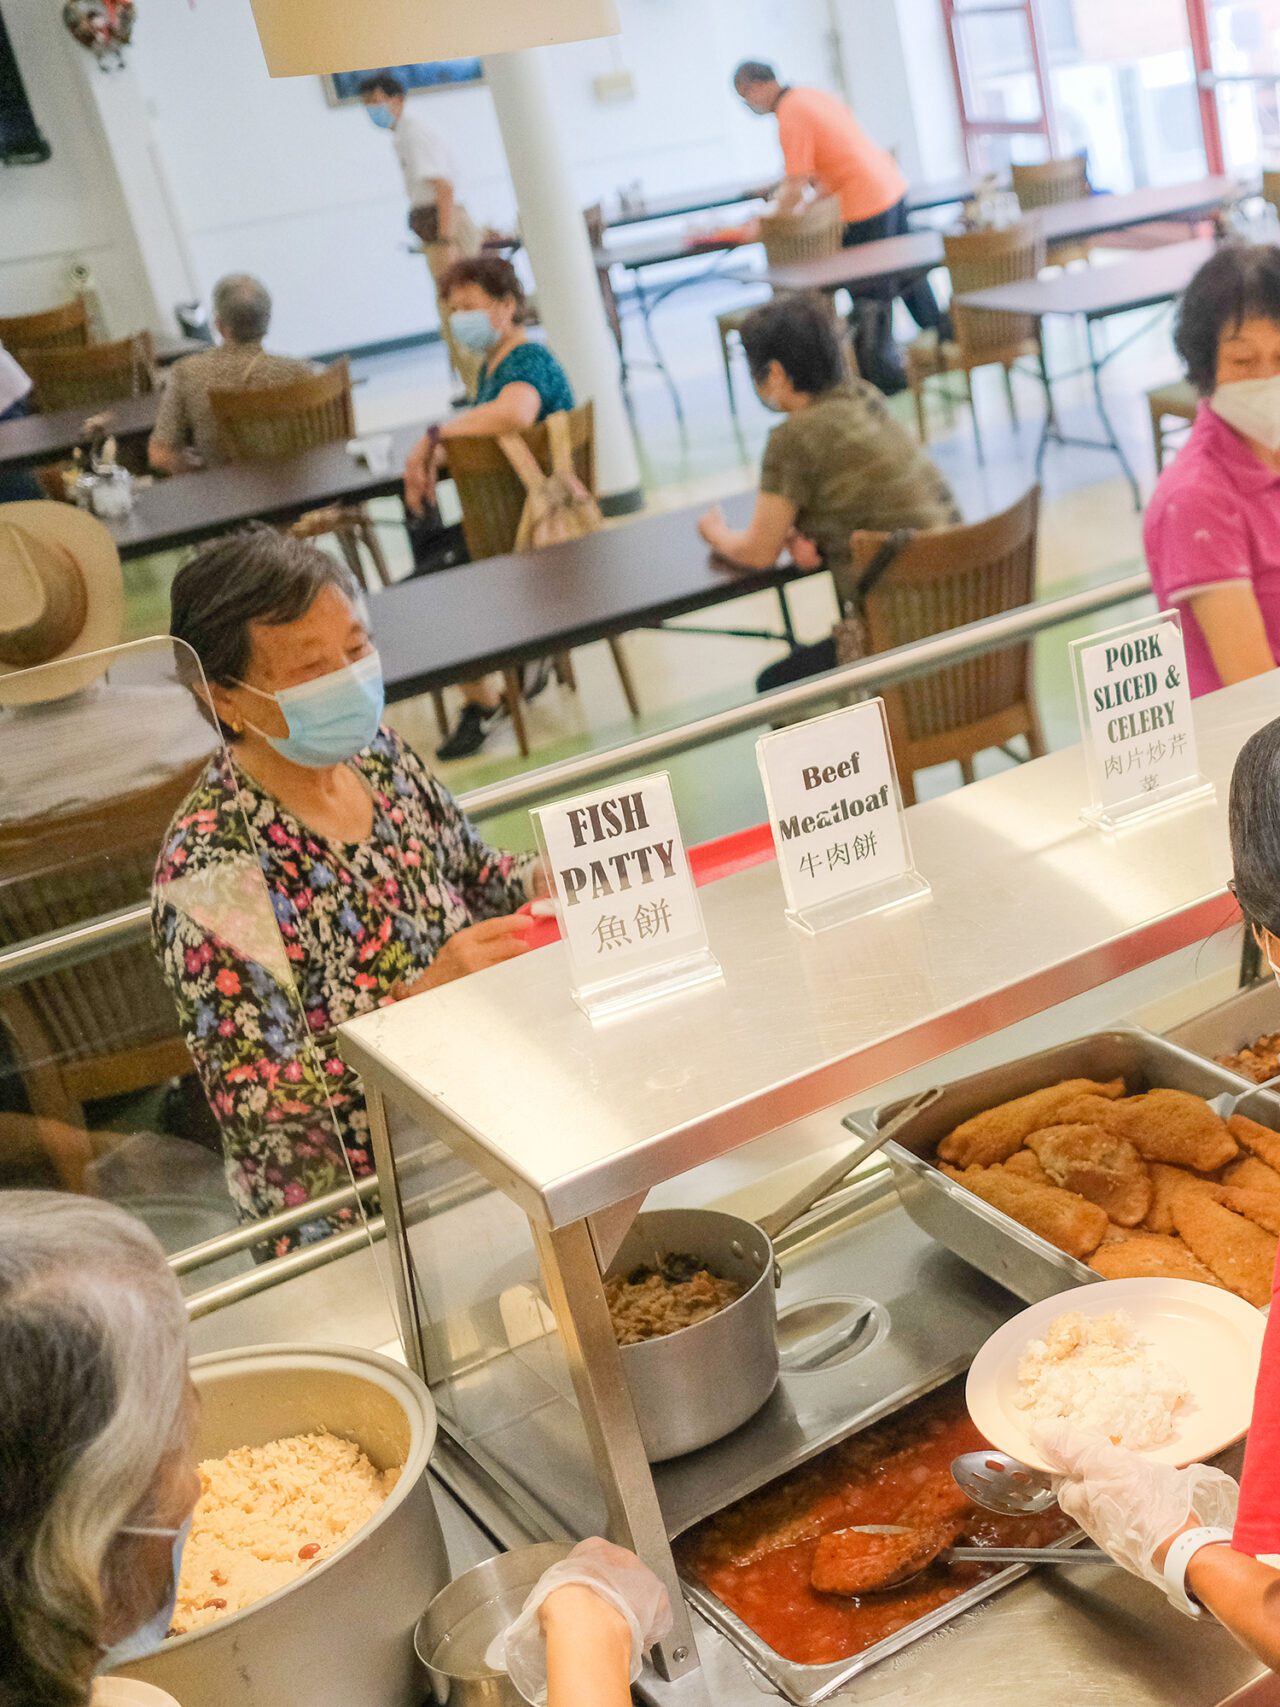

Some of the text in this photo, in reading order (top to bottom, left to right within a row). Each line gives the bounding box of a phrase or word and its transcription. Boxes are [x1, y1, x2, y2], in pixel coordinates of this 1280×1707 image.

[1105, 633, 1163, 673] PORK
[1093, 664, 1181, 713] SLICED &
[1107, 700, 1175, 744] CELERY
[801, 751, 861, 791] Beef
[1104, 732, 1187, 780] 肉片炒芹
[566, 791, 650, 848] FISH
[779, 784, 889, 842] Meatloaf
[559, 839, 677, 907] PATTY
[799, 829, 878, 879] 牛肉餅
[591, 897, 672, 954] 魚餅
